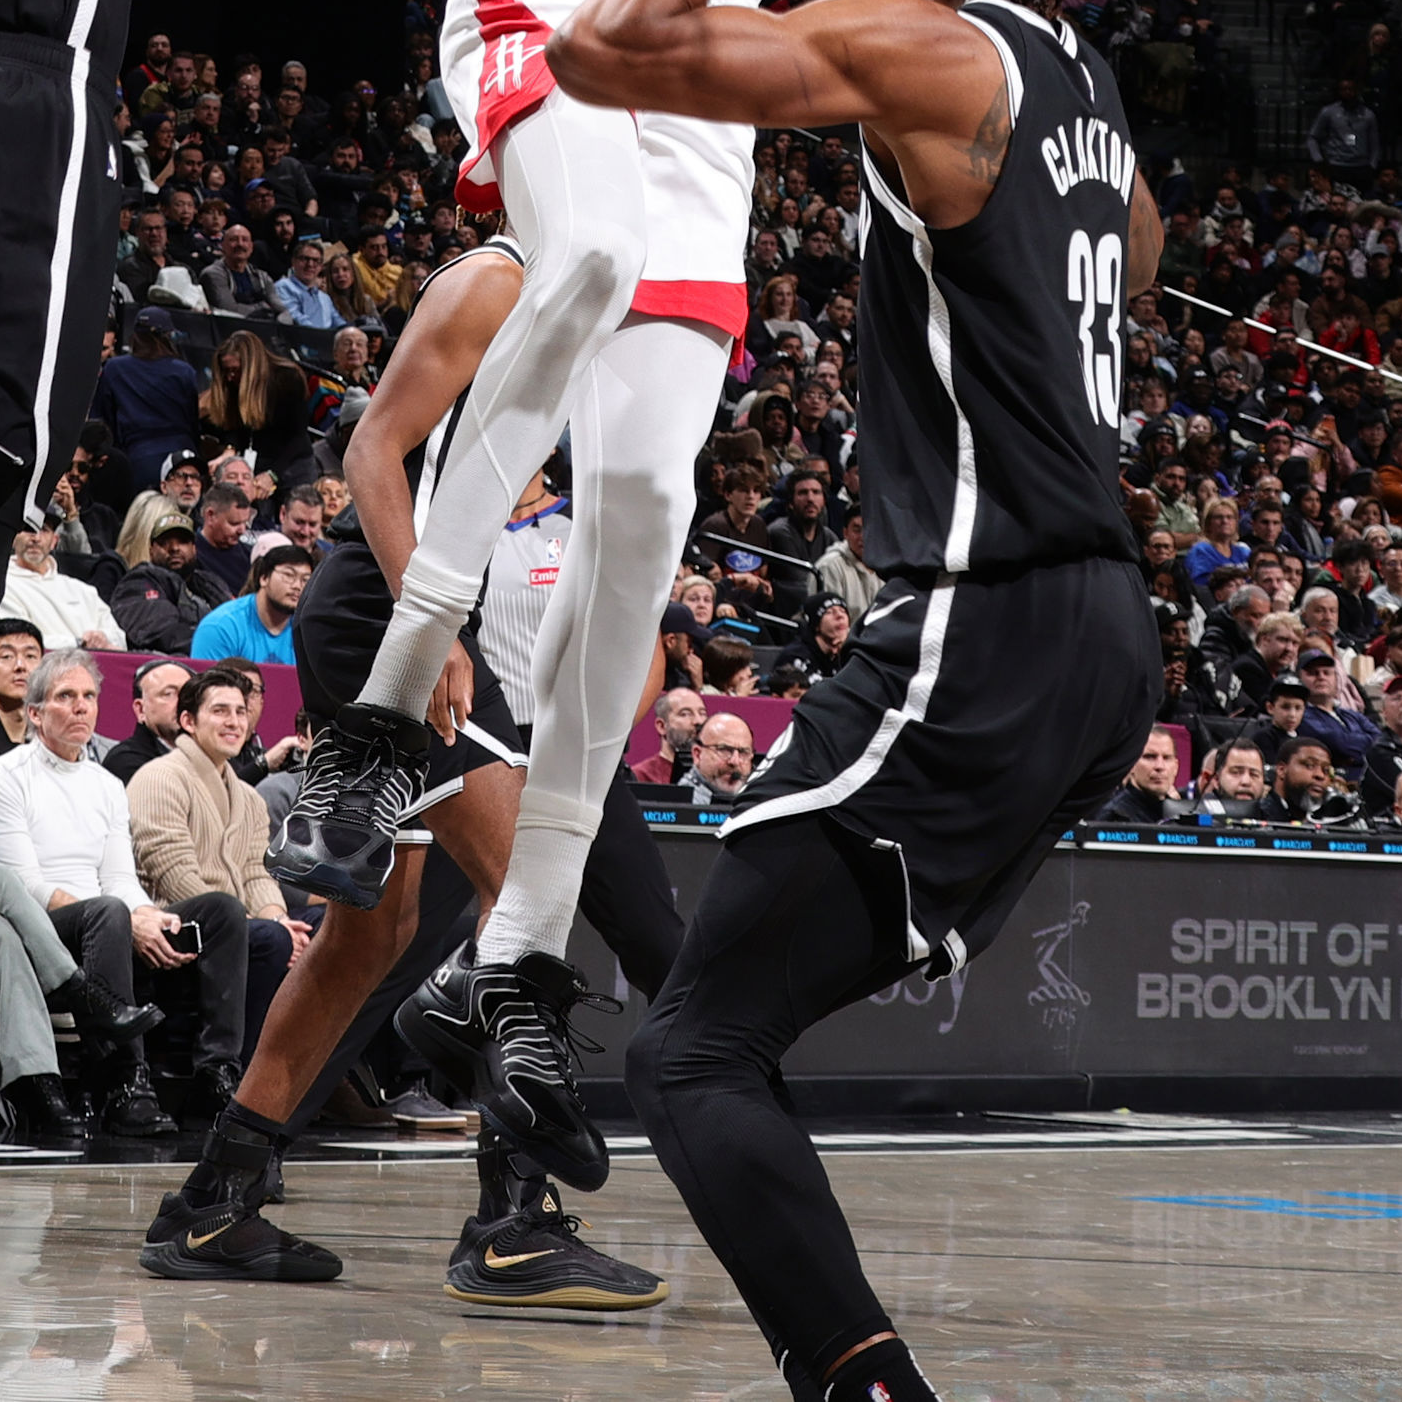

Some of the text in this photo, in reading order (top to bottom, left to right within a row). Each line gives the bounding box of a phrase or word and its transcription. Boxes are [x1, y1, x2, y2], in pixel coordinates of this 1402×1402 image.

[1105, 831, 1140, 842] BARCLAYS
[1170, 918, 1318, 965] SPIRIT
[1327, 923, 1389, 967] OF
[1136, 973, 1391, 1021] BROOKLYN
